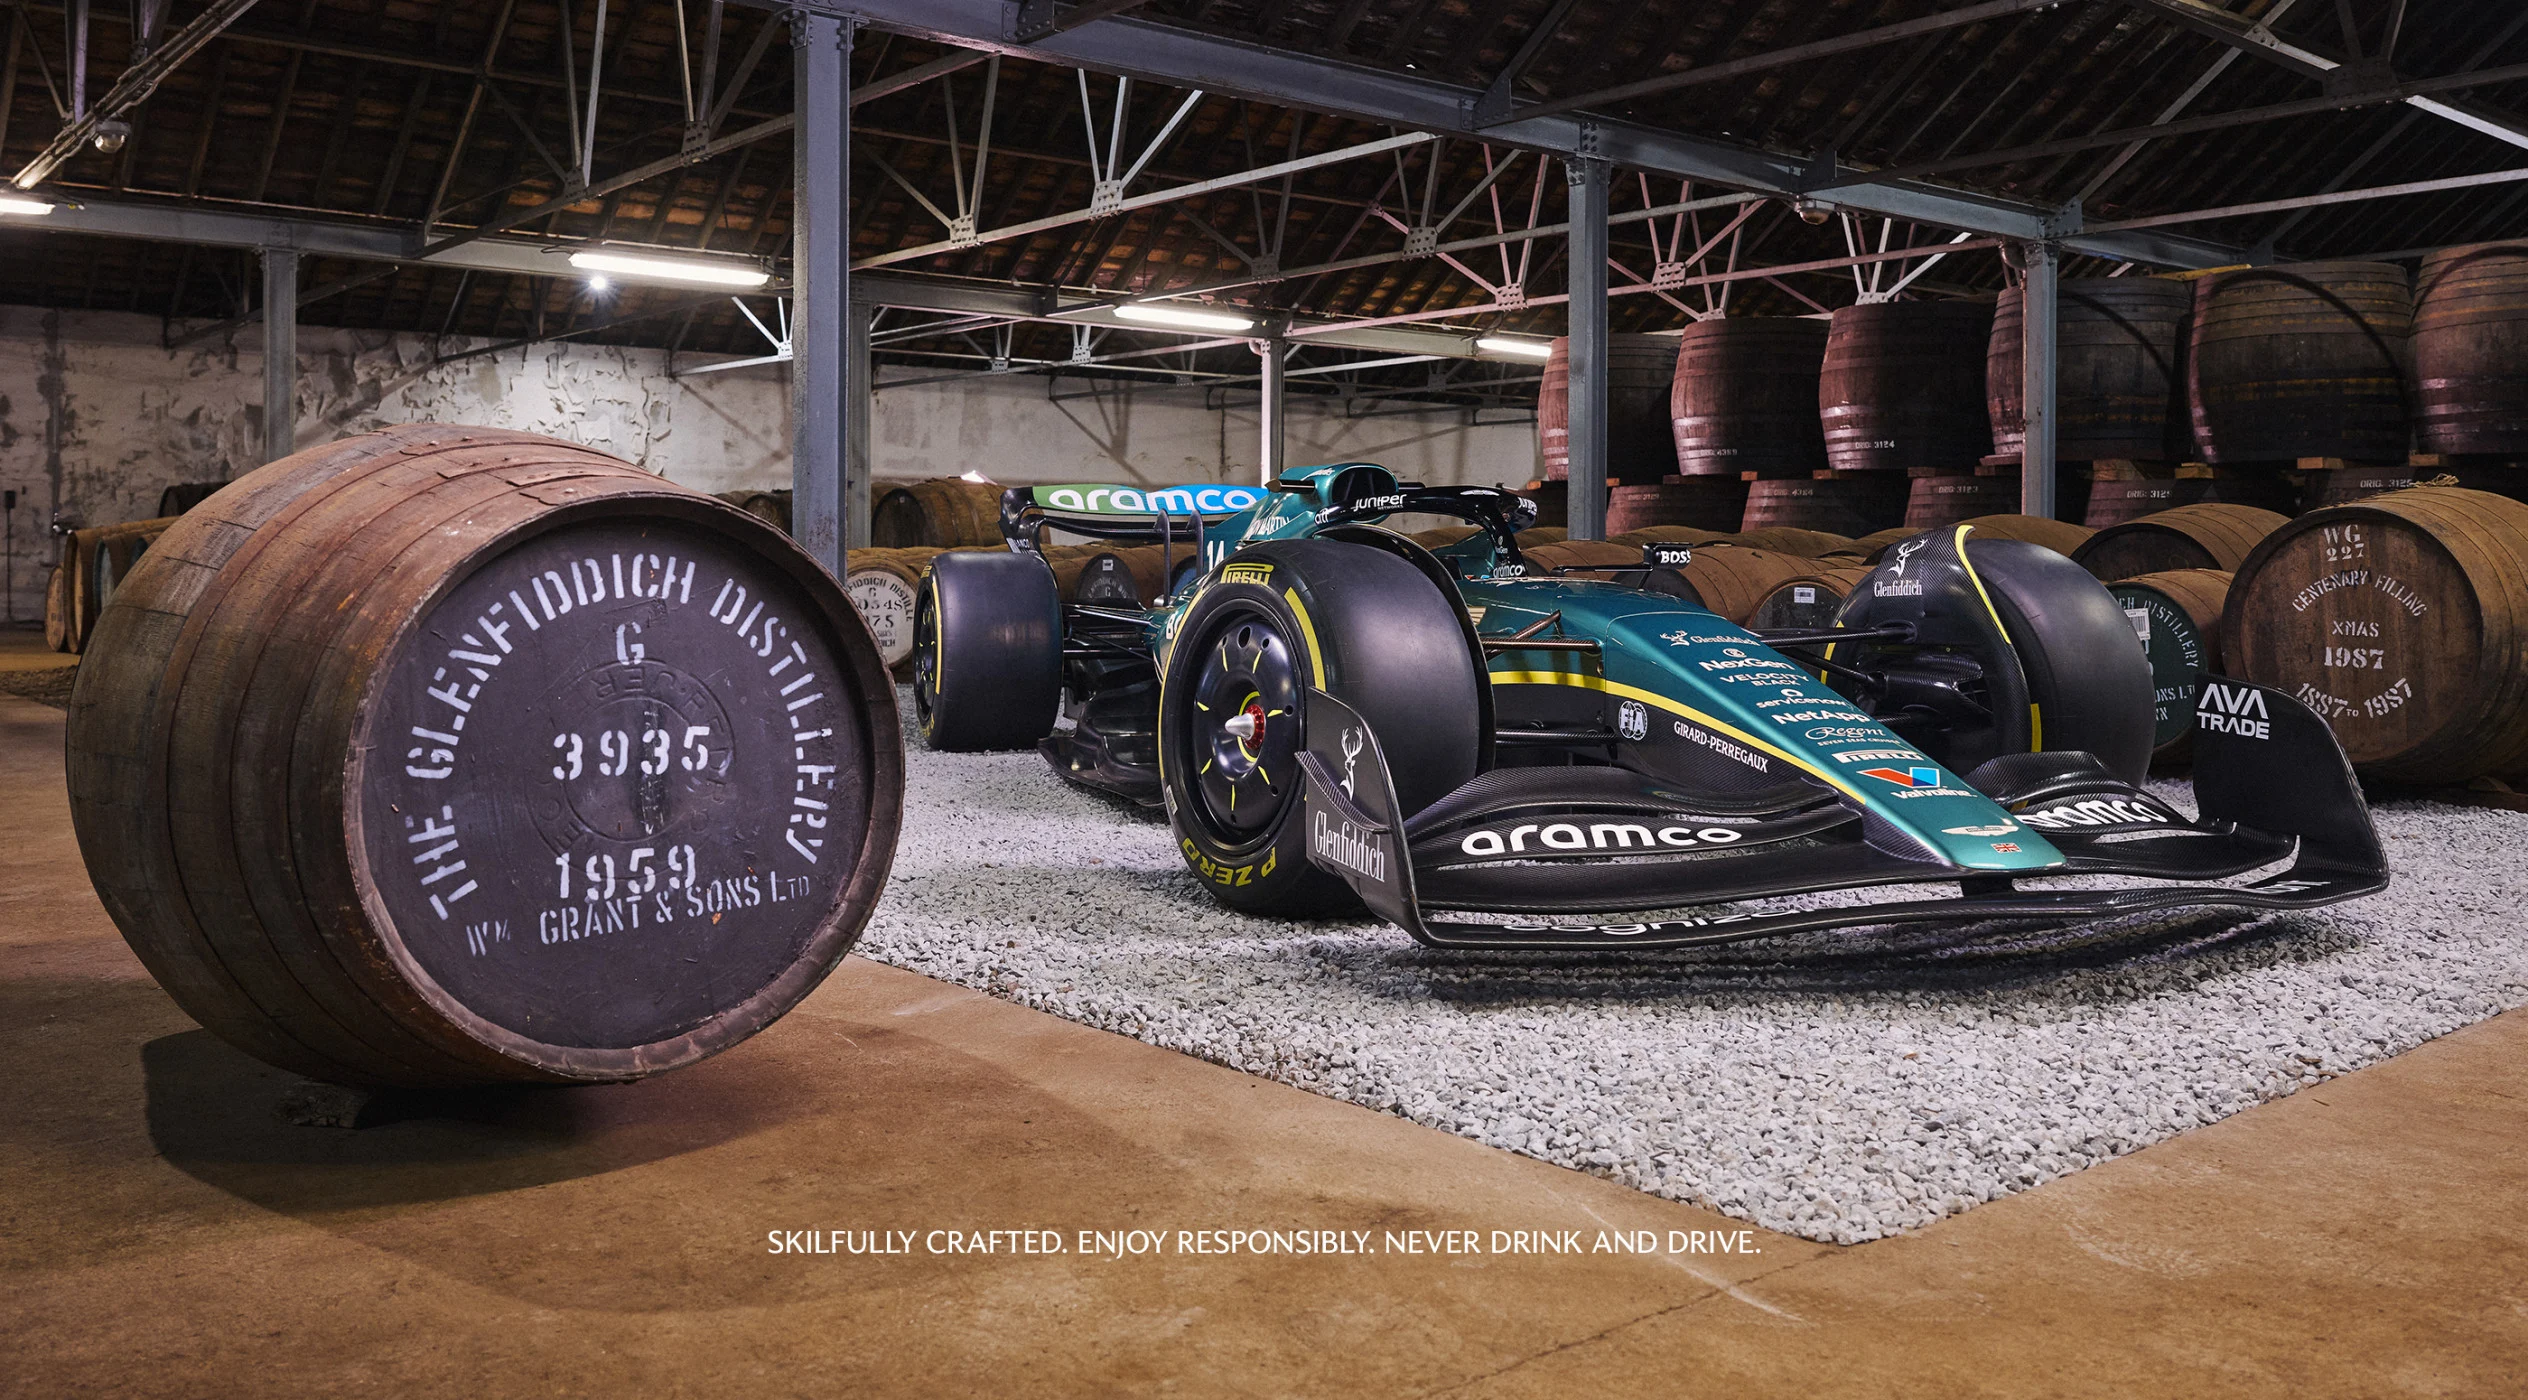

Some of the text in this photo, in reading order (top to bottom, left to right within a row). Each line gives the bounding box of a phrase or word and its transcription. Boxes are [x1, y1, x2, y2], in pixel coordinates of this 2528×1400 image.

[1874, 439, 1896, 449] 3124
[1049, 489, 1257, 511] aramco
[2126, 489, 2147, 498] ORIG:
[1660, 548, 1692, 564] BOSS
[2326, 543, 2366, 562] 227
[847, 577, 887, 593] FIDDICH
[1220, 562, 1275, 586] PIRELLI
[1873, 579, 1923, 598] Glenfiddich
[2291, 569, 2428, 617] CENTENARY FILLING
[2332, 620, 2380, 637] XMAS
[616, 622, 645, 666] G
[1690, 635, 1761, 647] Glenfiddich
[405, 553, 697, 780] GLENFIDDICH
[1699, 658, 1796, 671] NexGen
[2324, 646, 2385, 670] 1987
[1719, 672, 1809, 684] VELOCITY
[1750, 679, 1801, 687] BLACK
[1756, 698, 1847, 708] servicenow
[2198, 683, 2269, 716] AVA
[2296, 677, 2413, 719] 1887 TO 1987
[709, 578, 838, 865] DISTILLERY
[1622, 707, 1647, 731] FIA
[1771, 710, 1871, 725] NetApp
[2197, 711, 2270, 741] TRADE
[1805, 727, 1886, 740] Regent
[553, 725, 711, 781] 3935
[1673, 720, 1770, 774] GIRARD-PERREGAUX
[1831, 749, 1925, 764] PIRELLI
[1891, 788, 1973, 800] Valvoline
[1314, 809, 1386, 884] Glenfiddich
[1461, 823, 1743, 855] aramco
[405, 805, 478, 920] THE
[555, 844, 699, 901] 1959
[1181, 837, 1277, 887] P ZERO
[539, 895, 643, 946] GRANT
[655, 898, 675, 923] &
[686, 875, 761, 918] SONS
